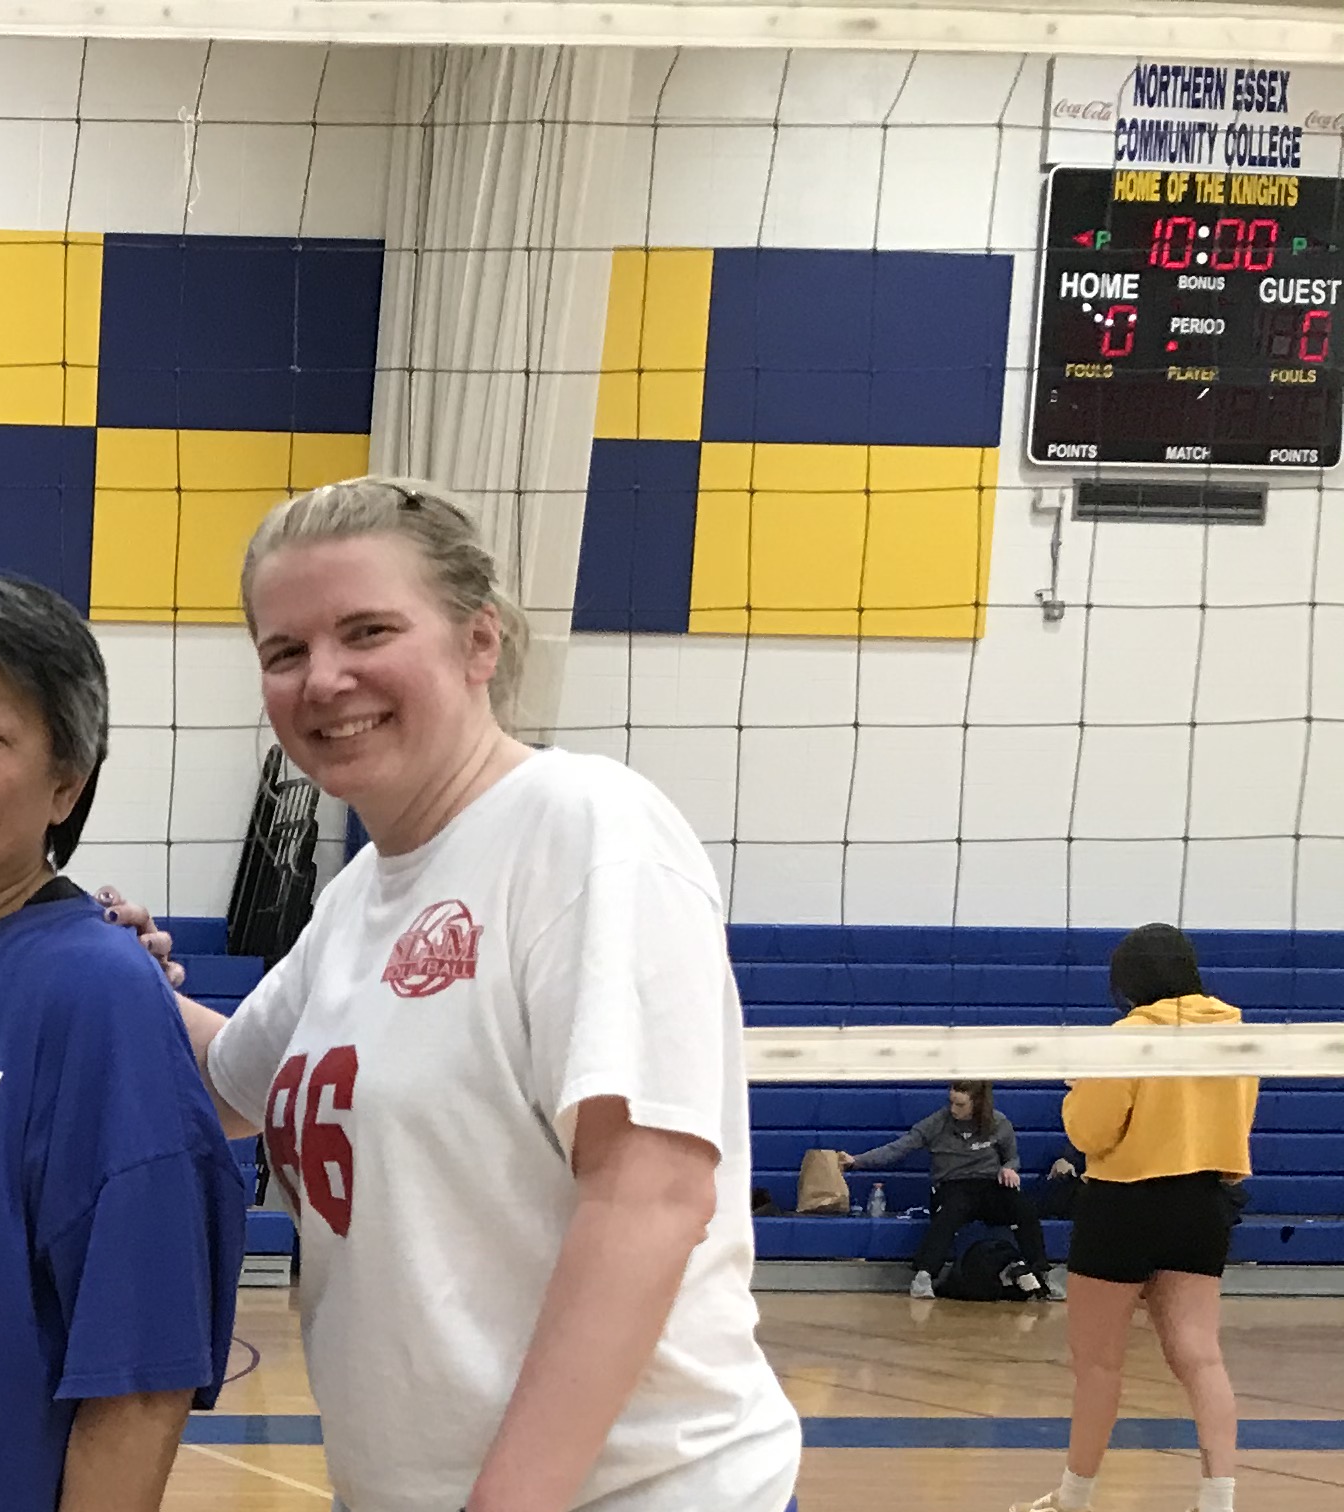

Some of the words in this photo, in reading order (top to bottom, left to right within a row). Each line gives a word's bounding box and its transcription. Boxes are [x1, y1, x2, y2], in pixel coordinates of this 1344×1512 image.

[1133, 63, 1228, 111] NORTHERN
[1232, 68, 1291, 113] ESSEX
[1114, 117, 1219, 165] COMMUNITY
[1224, 123, 1303, 169] COLLEGE
[1114, 171, 1161, 202] HOME
[1167, 172, 1190, 202] OF
[1195, 174, 1225, 204] THE
[1231, 175, 1299, 207] KNIGHTS
[1148, 216, 1279, 271] 10:00
[1061, 272, 1141, 299] HOME
[1178, 276, 1226, 291] BONUS
[1259, 278, 1343, 305] GUEST
[1170, 317, 1226, 335] PERIOD
[1065, 363, 1114, 379] FOULS
[1269, 369, 1317, 383] FOULS
[1047, 444, 1098, 459] POINTS
[1165, 446, 1211, 460] MATCH
[1269, 449, 1318, 464] POINTS
